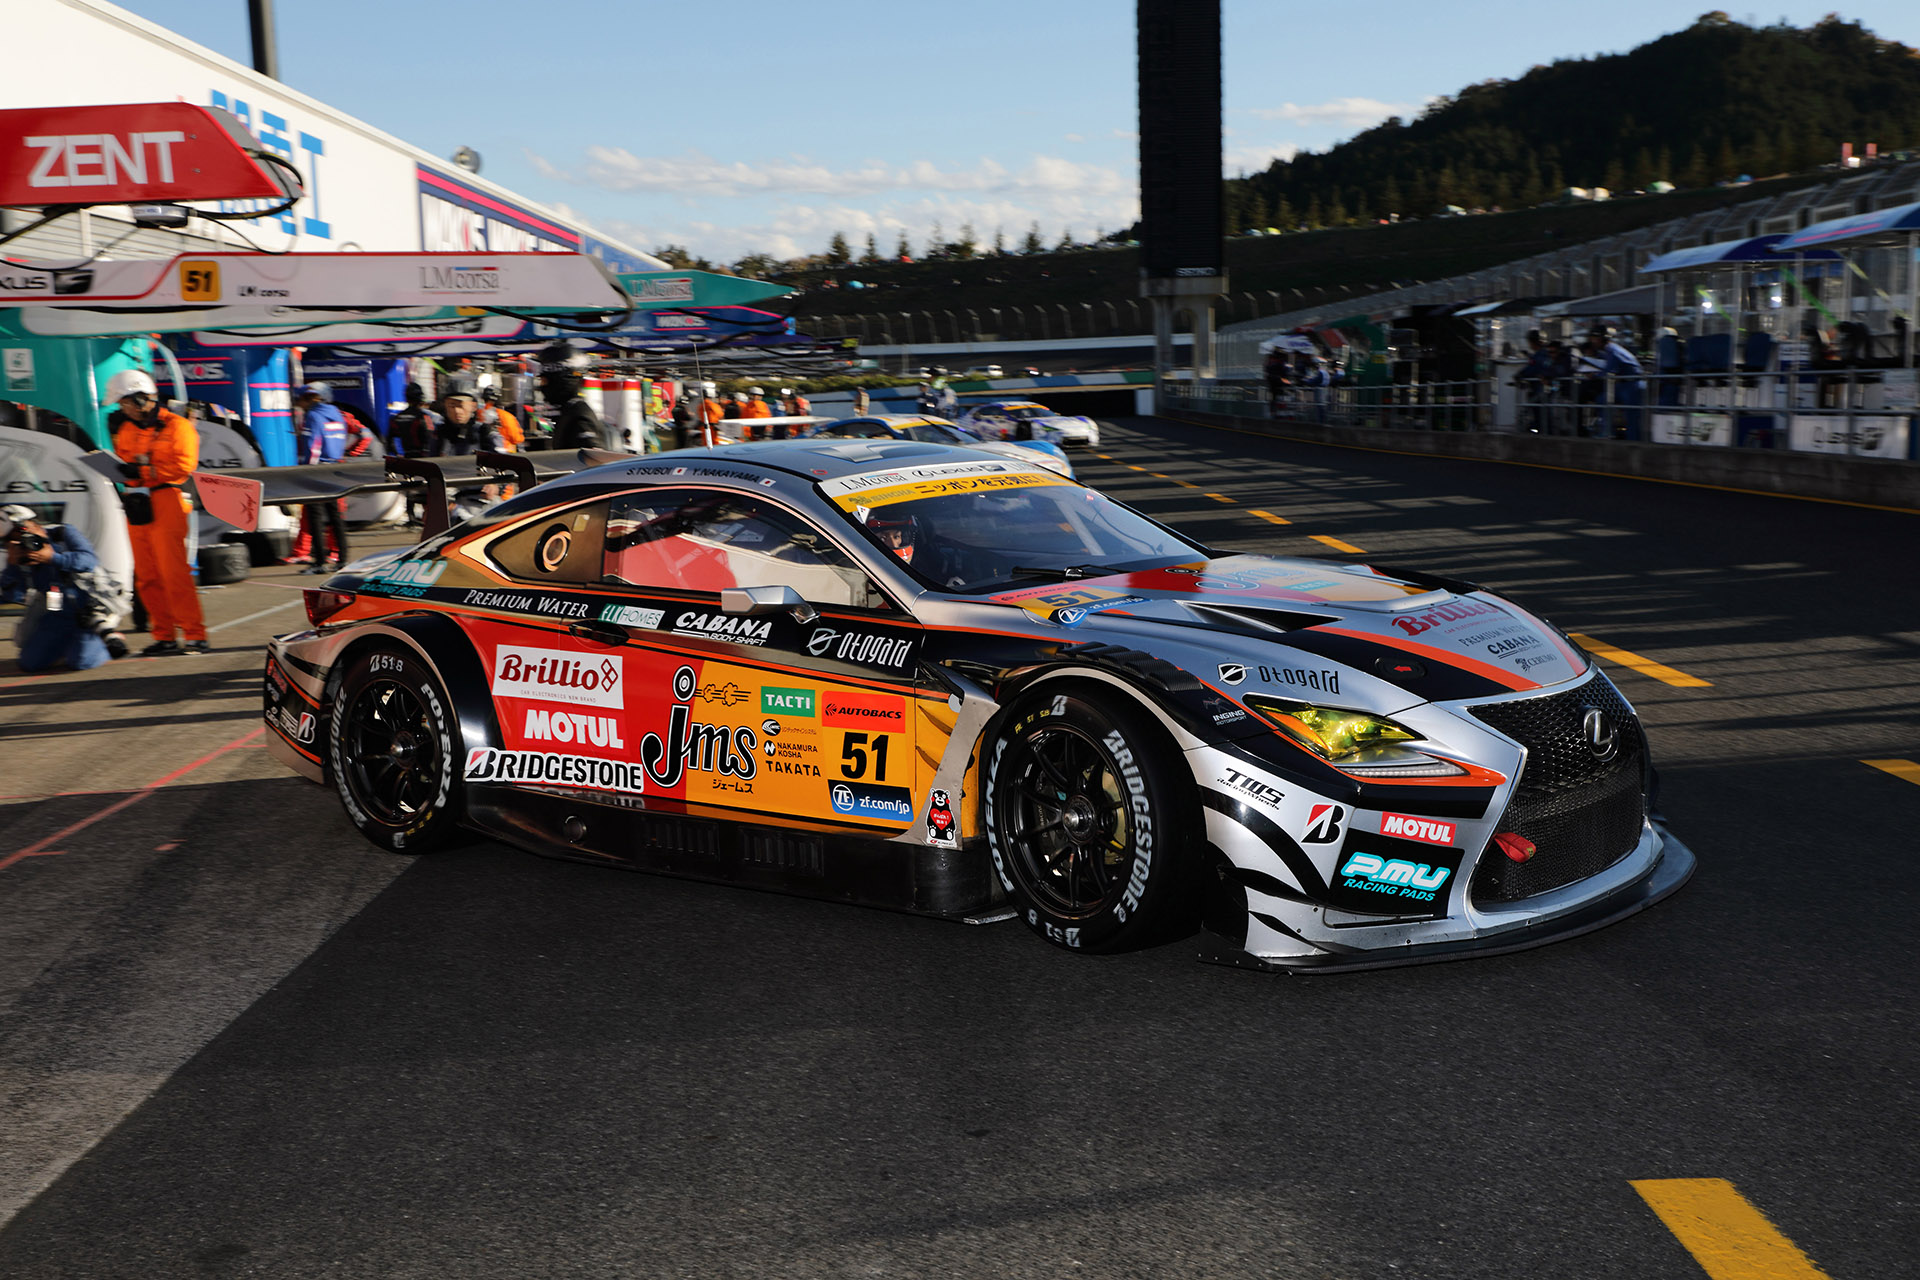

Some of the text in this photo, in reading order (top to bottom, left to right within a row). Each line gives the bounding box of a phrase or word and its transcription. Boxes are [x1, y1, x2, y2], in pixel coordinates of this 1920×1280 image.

[23, 130, 185, 187] ZENT
[185, 270, 213, 292] 51
[463, 590, 589, 618] PREMIUM WATER
[1037, 590, 1102, 606] 51
[621, 609, 661, 626] HOMES
[676, 611, 772, 639] CABANA
[1391, 602, 1499, 636] Brillio
[710, 632, 767, 646] BODY SHAFT
[1487, 634, 1540, 655] CABANA
[499, 654, 599, 691] Brillio
[765, 693, 811, 710] TACTI
[838, 706, 902, 719] AUTOBACS
[1213, 709, 1245, 721] INGING
[524, 709, 624, 749] MOTUL
[420, 682, 452, 808] POTENZA
[777, 742, 818, 752] NAKAMURA
[777, 750, 802, 758] KOSHA
[841, 731, 889, 781] 51
[465, 748, 643, 791] BRIDGESTONE
[765, 760, 821, 777] TAKATA
[712, 778, 754, 794] ジェームス
[859, 796, 910, 815] zf.com/jp
[986, 737, 1014, 893] POTENZA
[1102, 729, 1153, 913] BRIDGESTONE
[1383, 816, 1452, 843] MOTUL
[1342, 878, 1436, 902] RACING PADS
